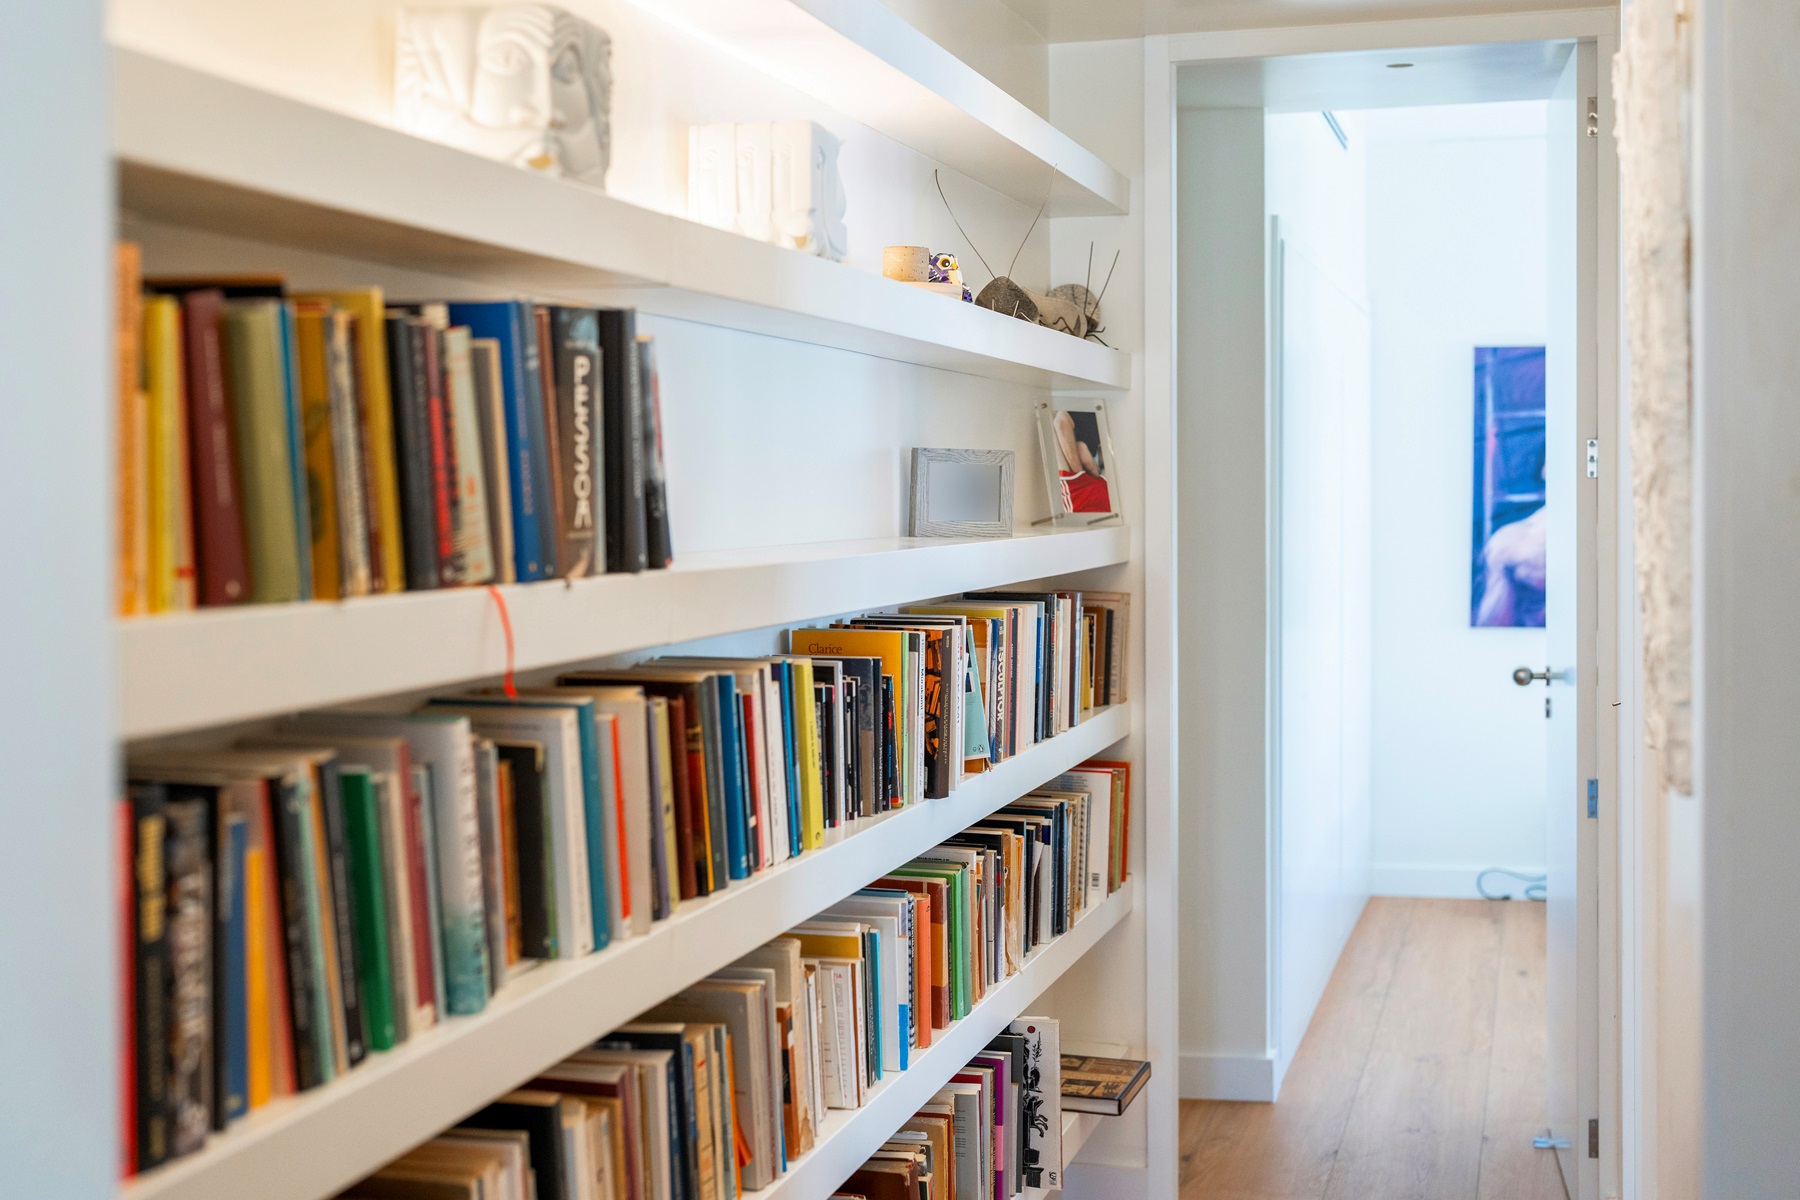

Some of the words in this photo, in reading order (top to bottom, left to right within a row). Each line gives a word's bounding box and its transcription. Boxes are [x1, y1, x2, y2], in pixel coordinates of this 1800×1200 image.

[573, 355, 593, 528] PESSOA
[808, 642, 843, 655] Clarice
[997, 651, 1005, 721] SCULPTOR
